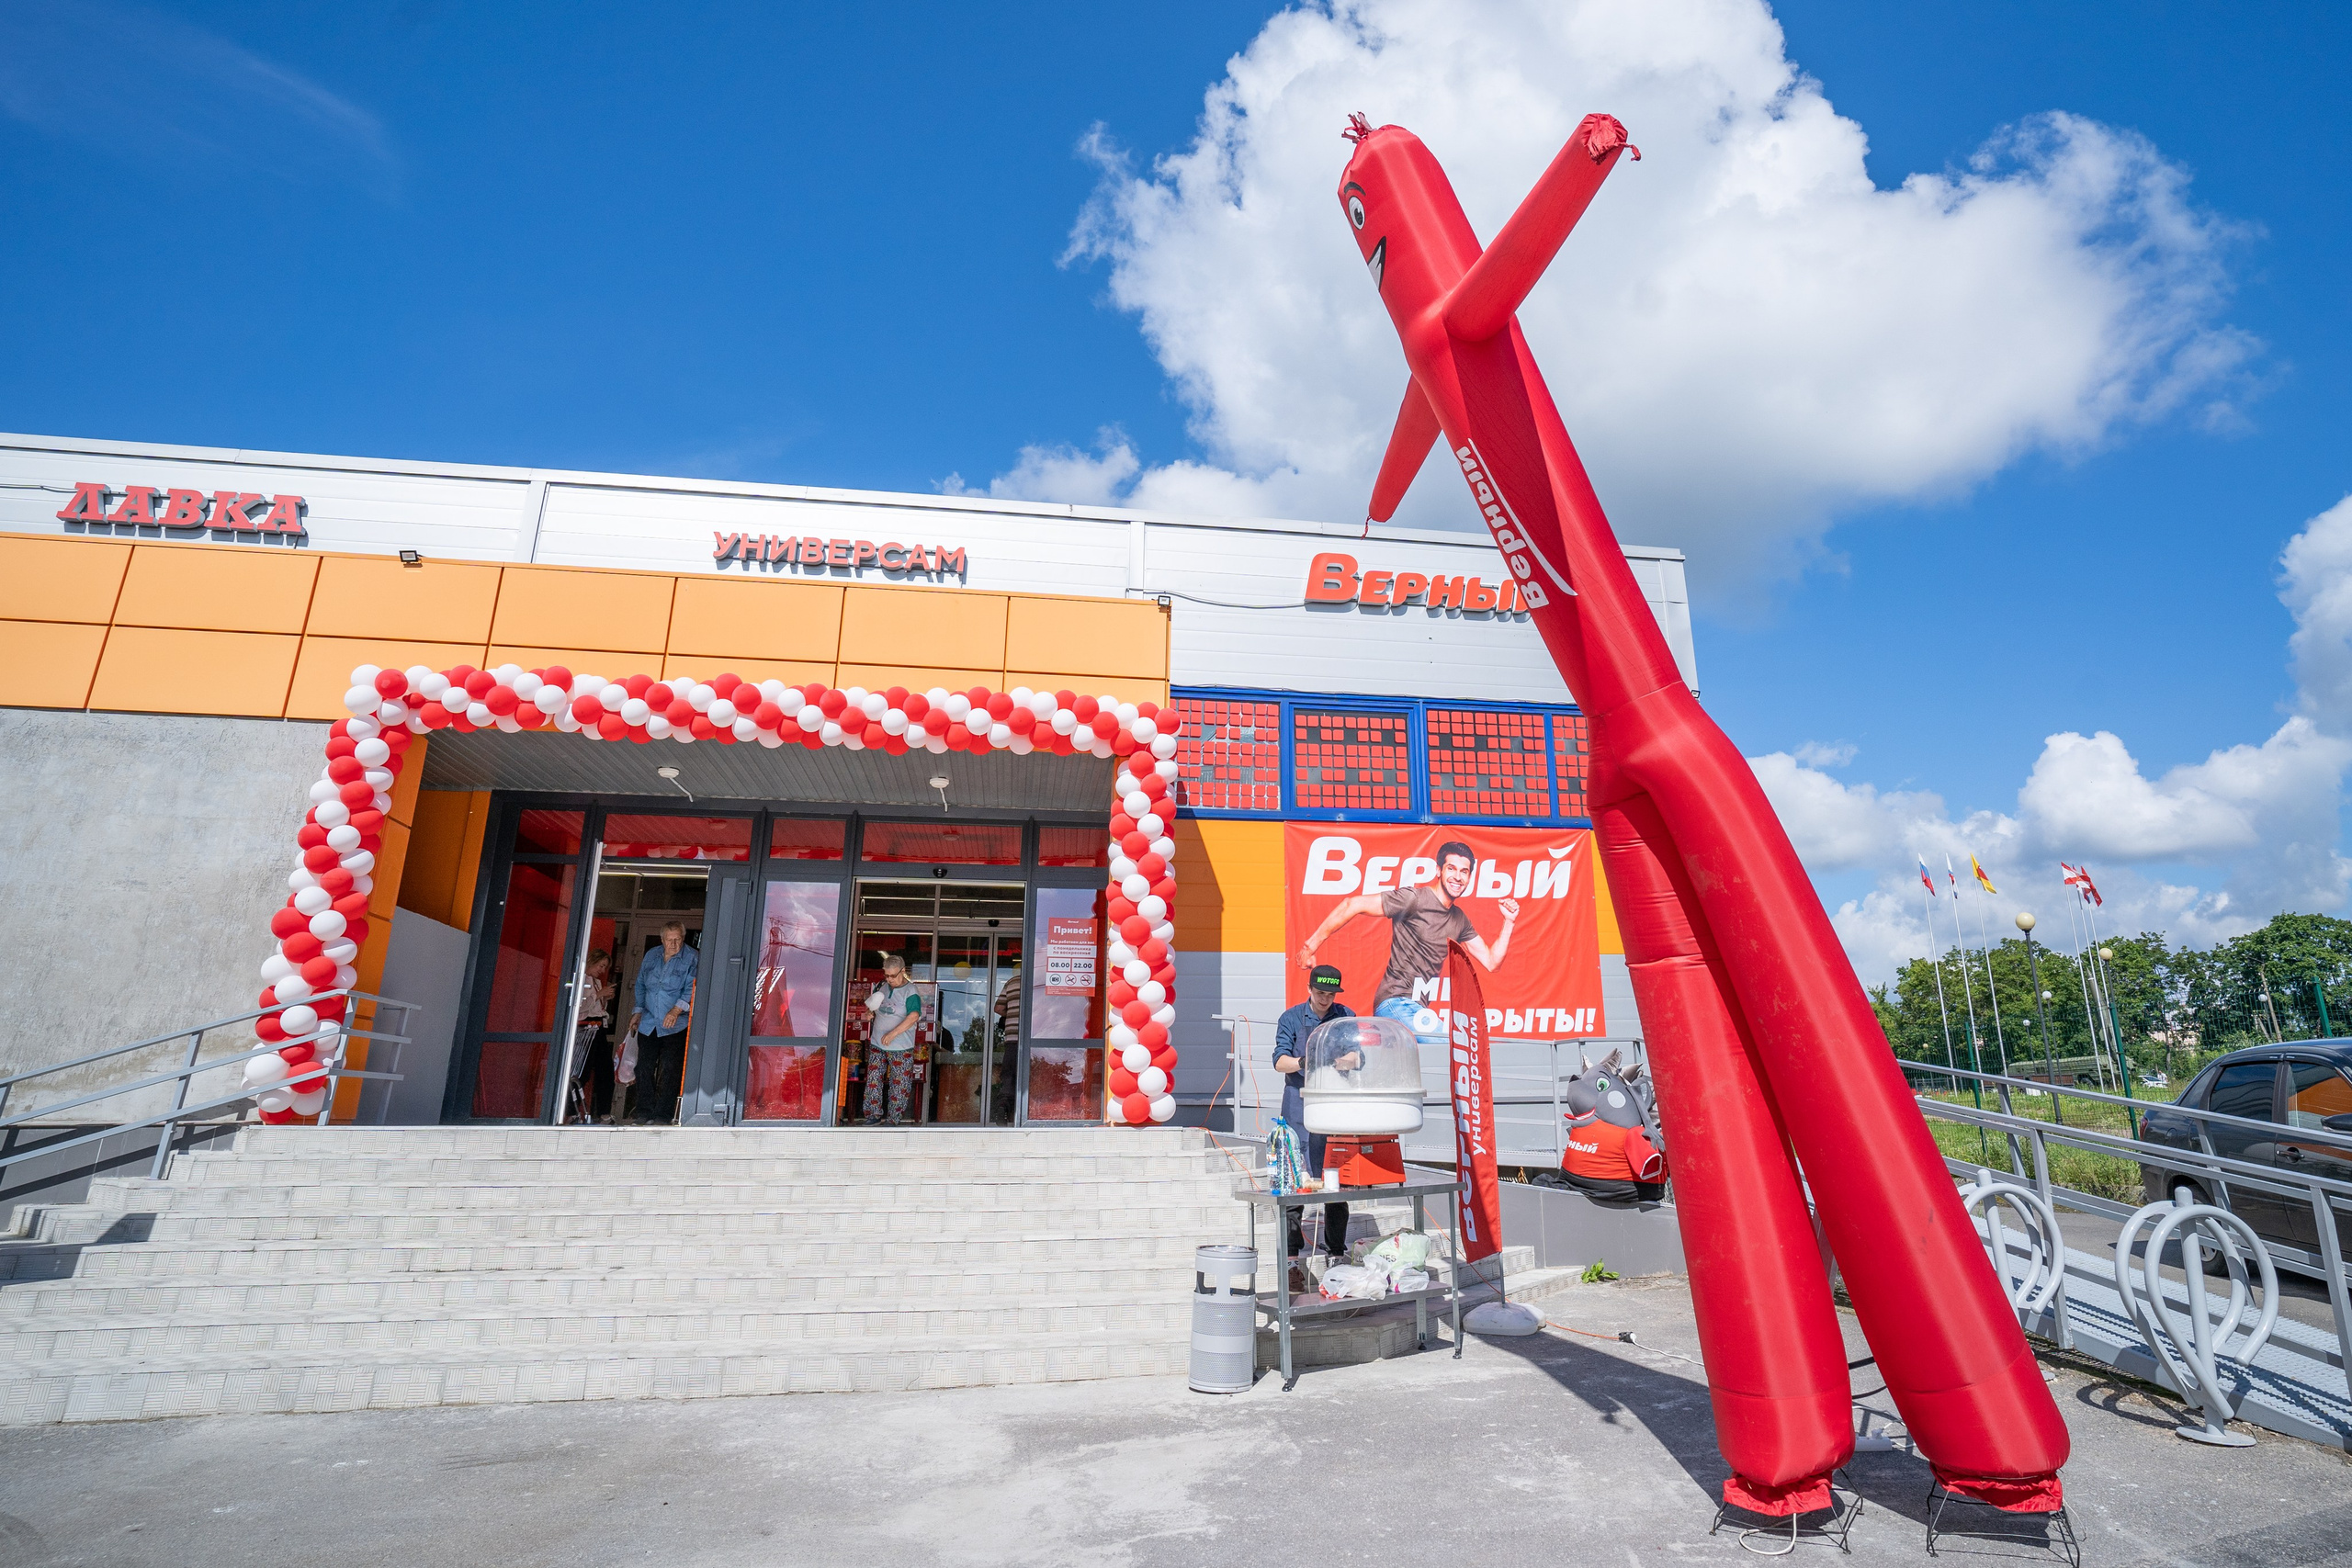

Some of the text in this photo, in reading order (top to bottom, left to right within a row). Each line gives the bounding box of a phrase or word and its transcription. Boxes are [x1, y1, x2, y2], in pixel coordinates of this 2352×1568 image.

[56, 481, 306, 536] ЛАВКА
[712, 531, 966, 574] УНИВЕРСАМ
[1304, 552, 1528, 613] ВЕРНЫ
[1302, 836, 1577, 899] ВЕРЫЙ
[1053, 925, 1092, 936] Привет!
[1412, 976, 1450, 1001] М
[1413, 1008, 1597, 1033] ОТРЫТЫ!
